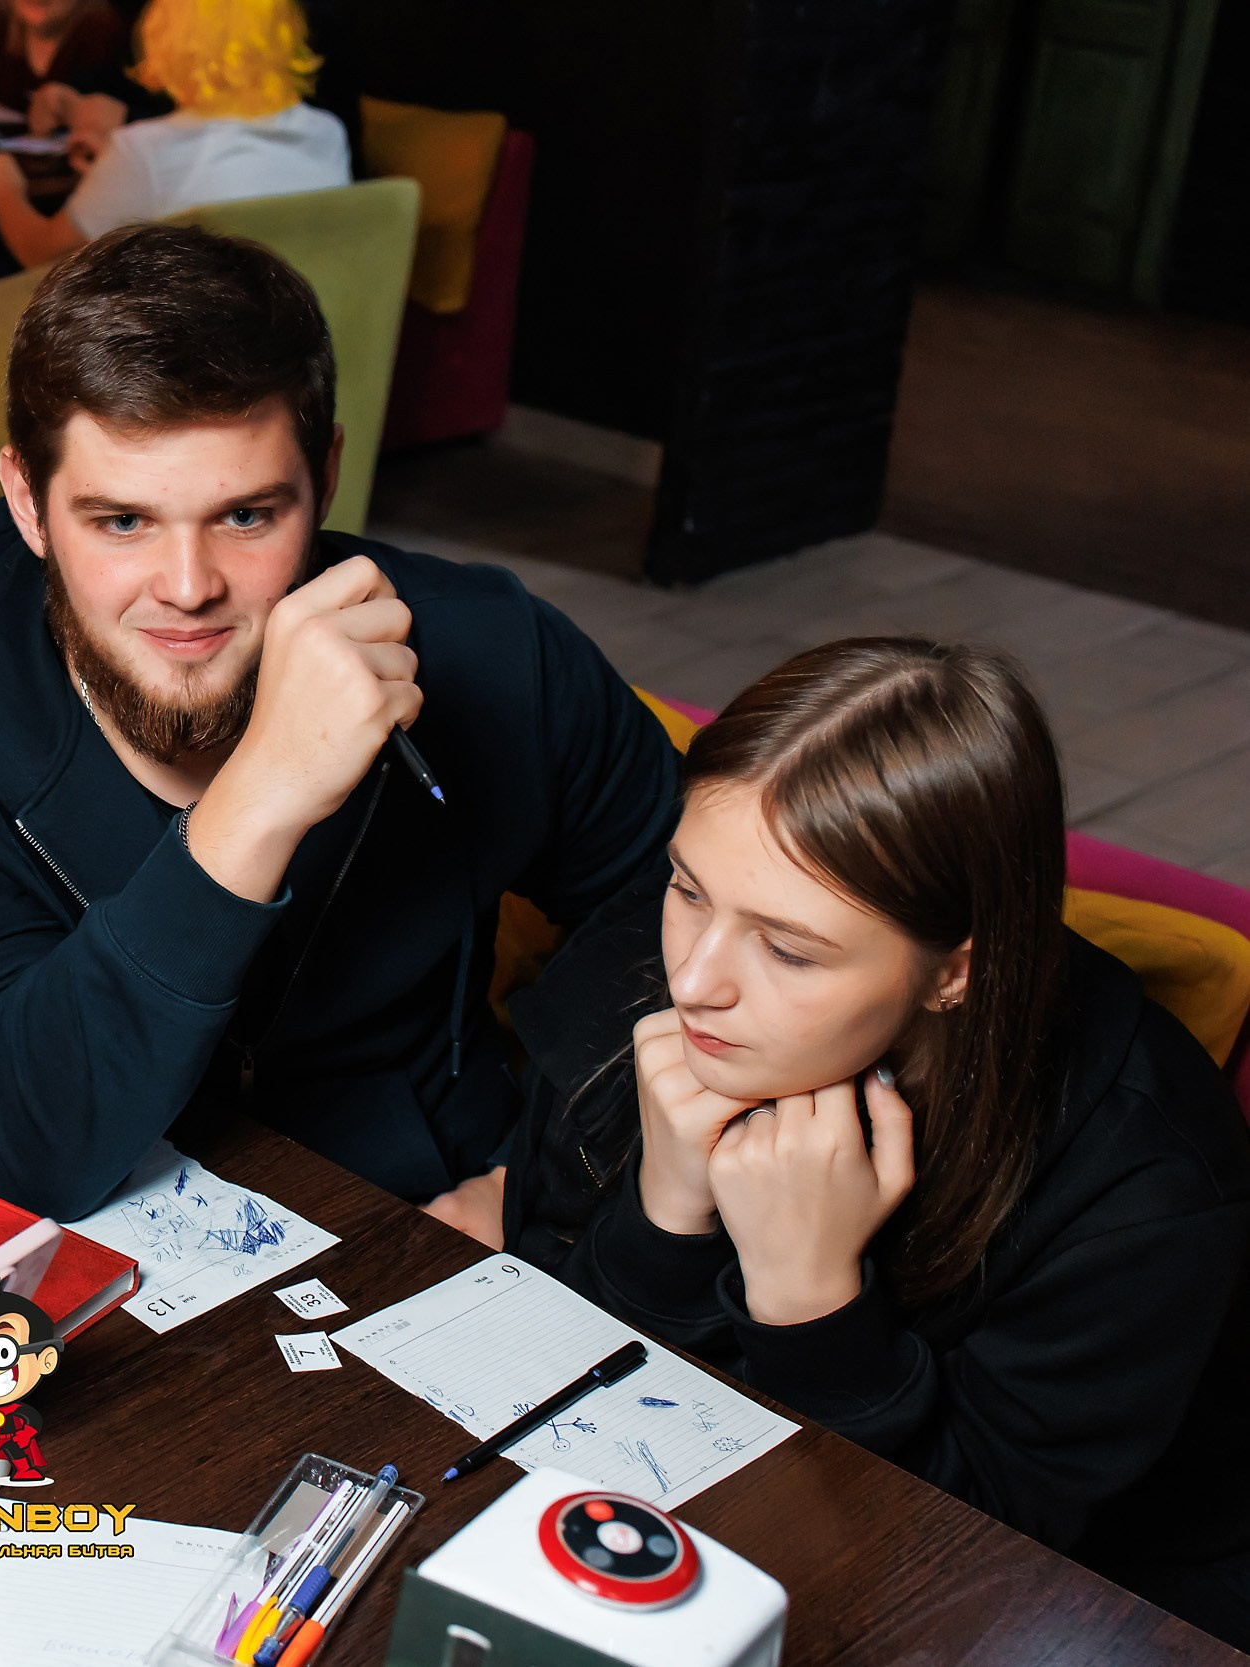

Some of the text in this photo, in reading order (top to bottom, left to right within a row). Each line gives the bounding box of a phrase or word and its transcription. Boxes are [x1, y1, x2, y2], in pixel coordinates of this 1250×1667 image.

[501, 1264, 520, 1278] 9
[147, 1297, 177, 1316] 13
[300, 1293, 322, 1308] 33
[298, 1350, 316, 1358] 7
